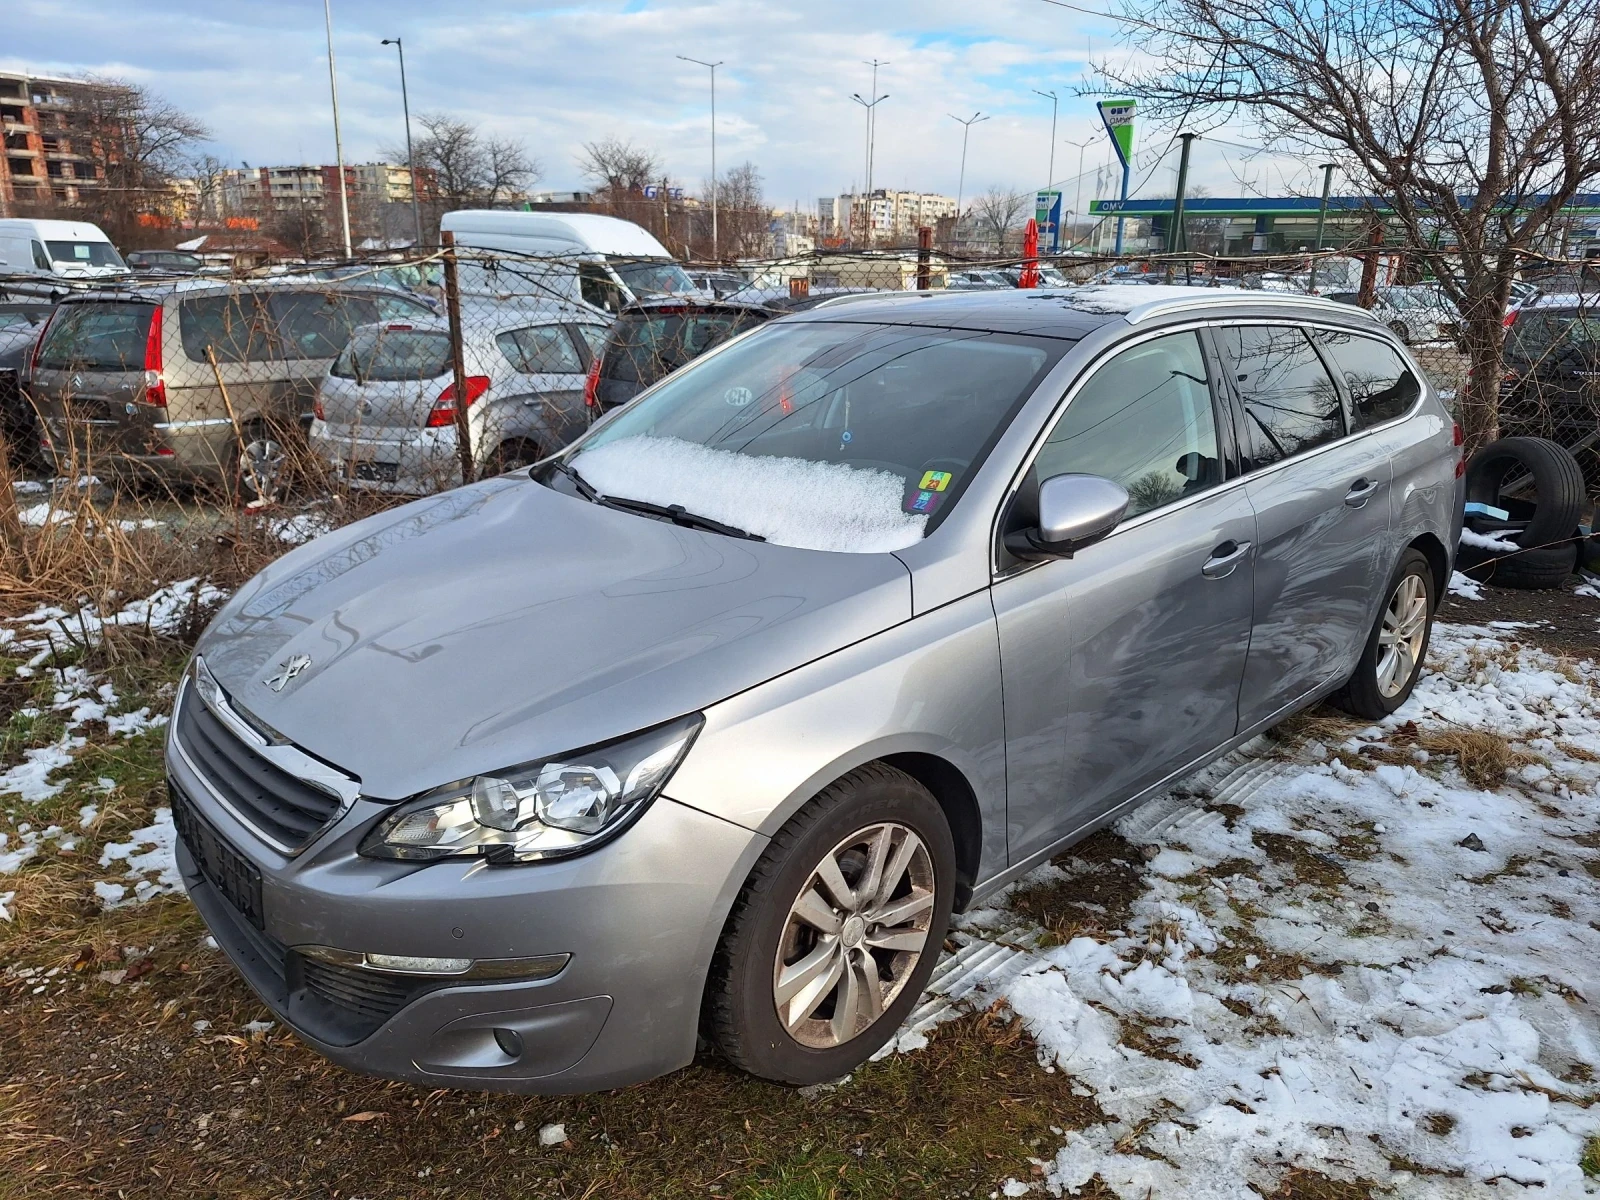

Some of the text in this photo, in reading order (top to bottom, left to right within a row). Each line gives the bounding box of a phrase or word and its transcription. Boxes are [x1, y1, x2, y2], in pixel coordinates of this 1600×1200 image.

[1109, 116, 1131, 124] OMV
[1102, 202, 1125, 211] OMV
[728, 389, 747, 404] CH
[912, 499, 928, 510] 22
